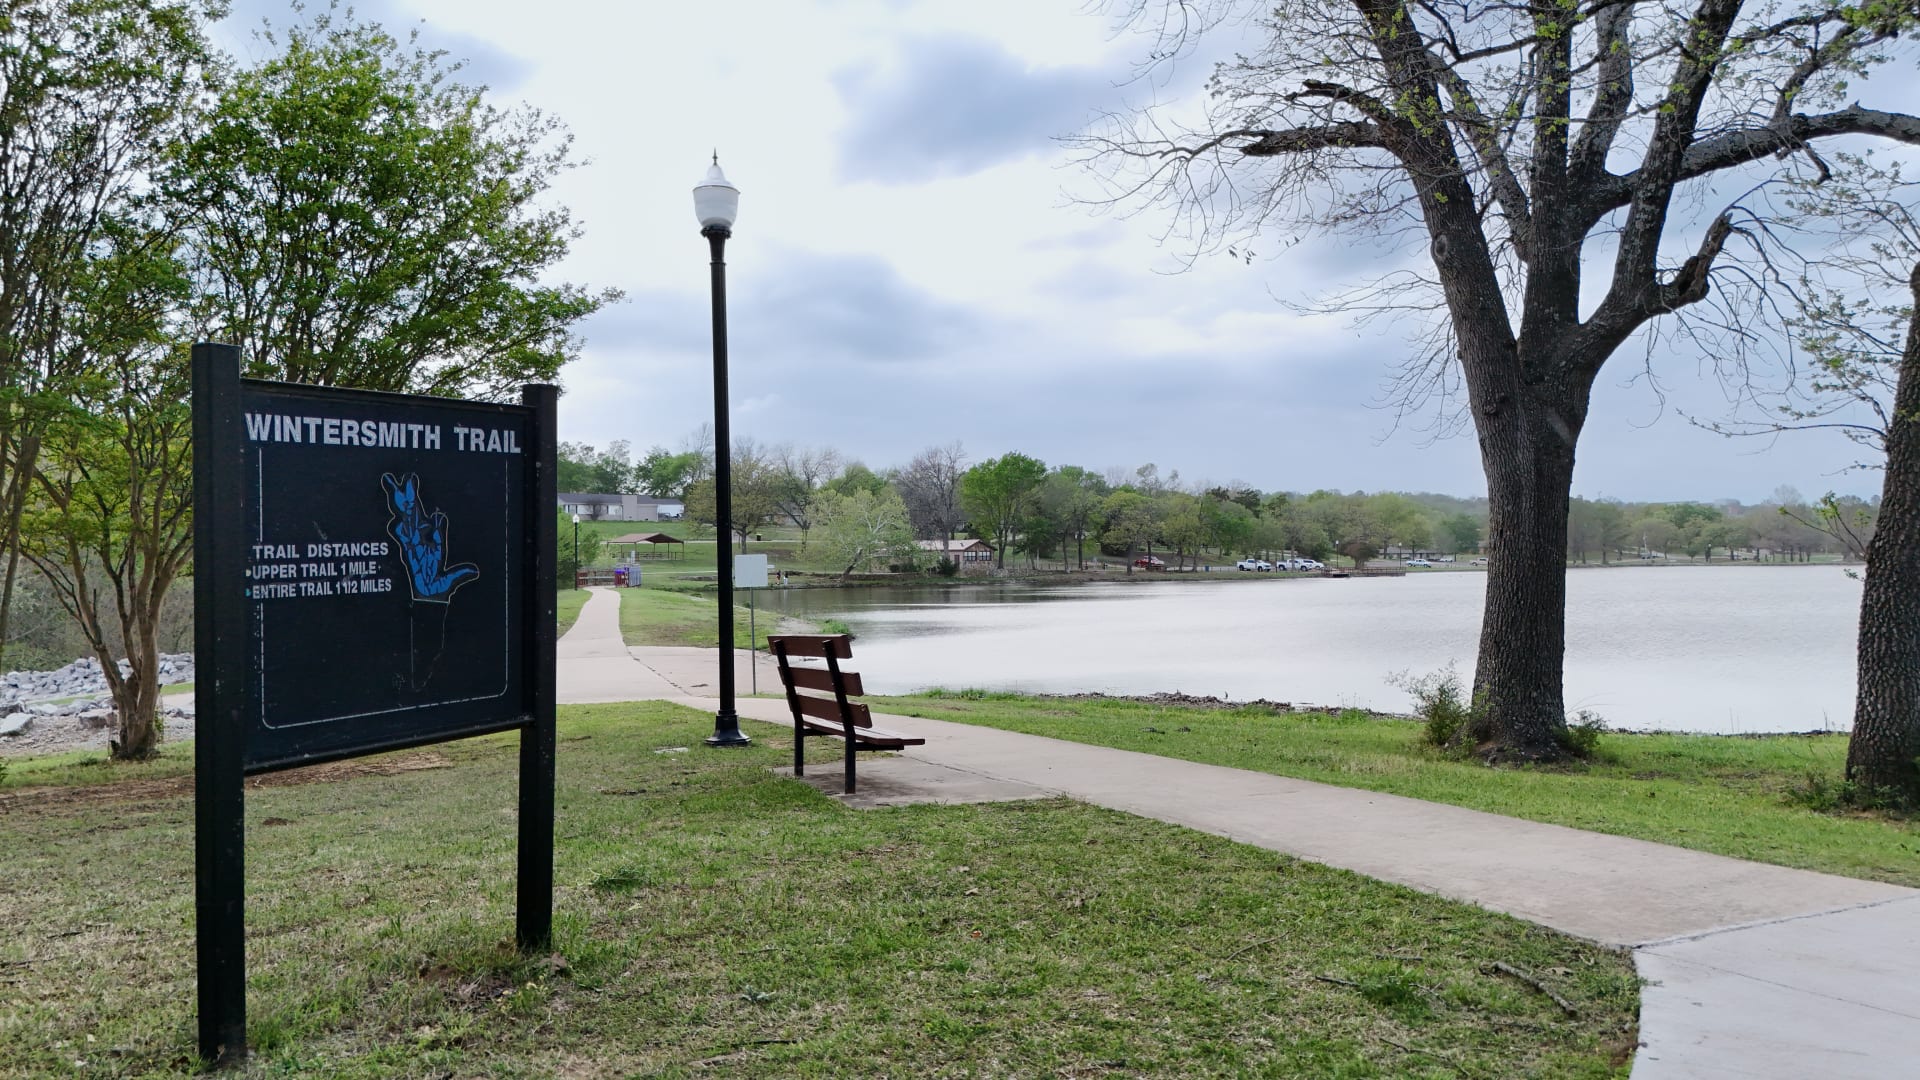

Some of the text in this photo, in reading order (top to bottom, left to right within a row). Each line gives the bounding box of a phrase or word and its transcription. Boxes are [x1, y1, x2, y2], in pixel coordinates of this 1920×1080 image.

[245, 412, 522, 454] WINTERSMITH TRAIL
[252, 542, 389, 560] TRAIL DISTANCES
[252, 561, 377, 580] UPPER TRAIL 1 MILE
[252, 583, 297, 599] ENTIRE
[299, 581, 334, 597] TRAIL
[361, 578, 392, 593] MILES
